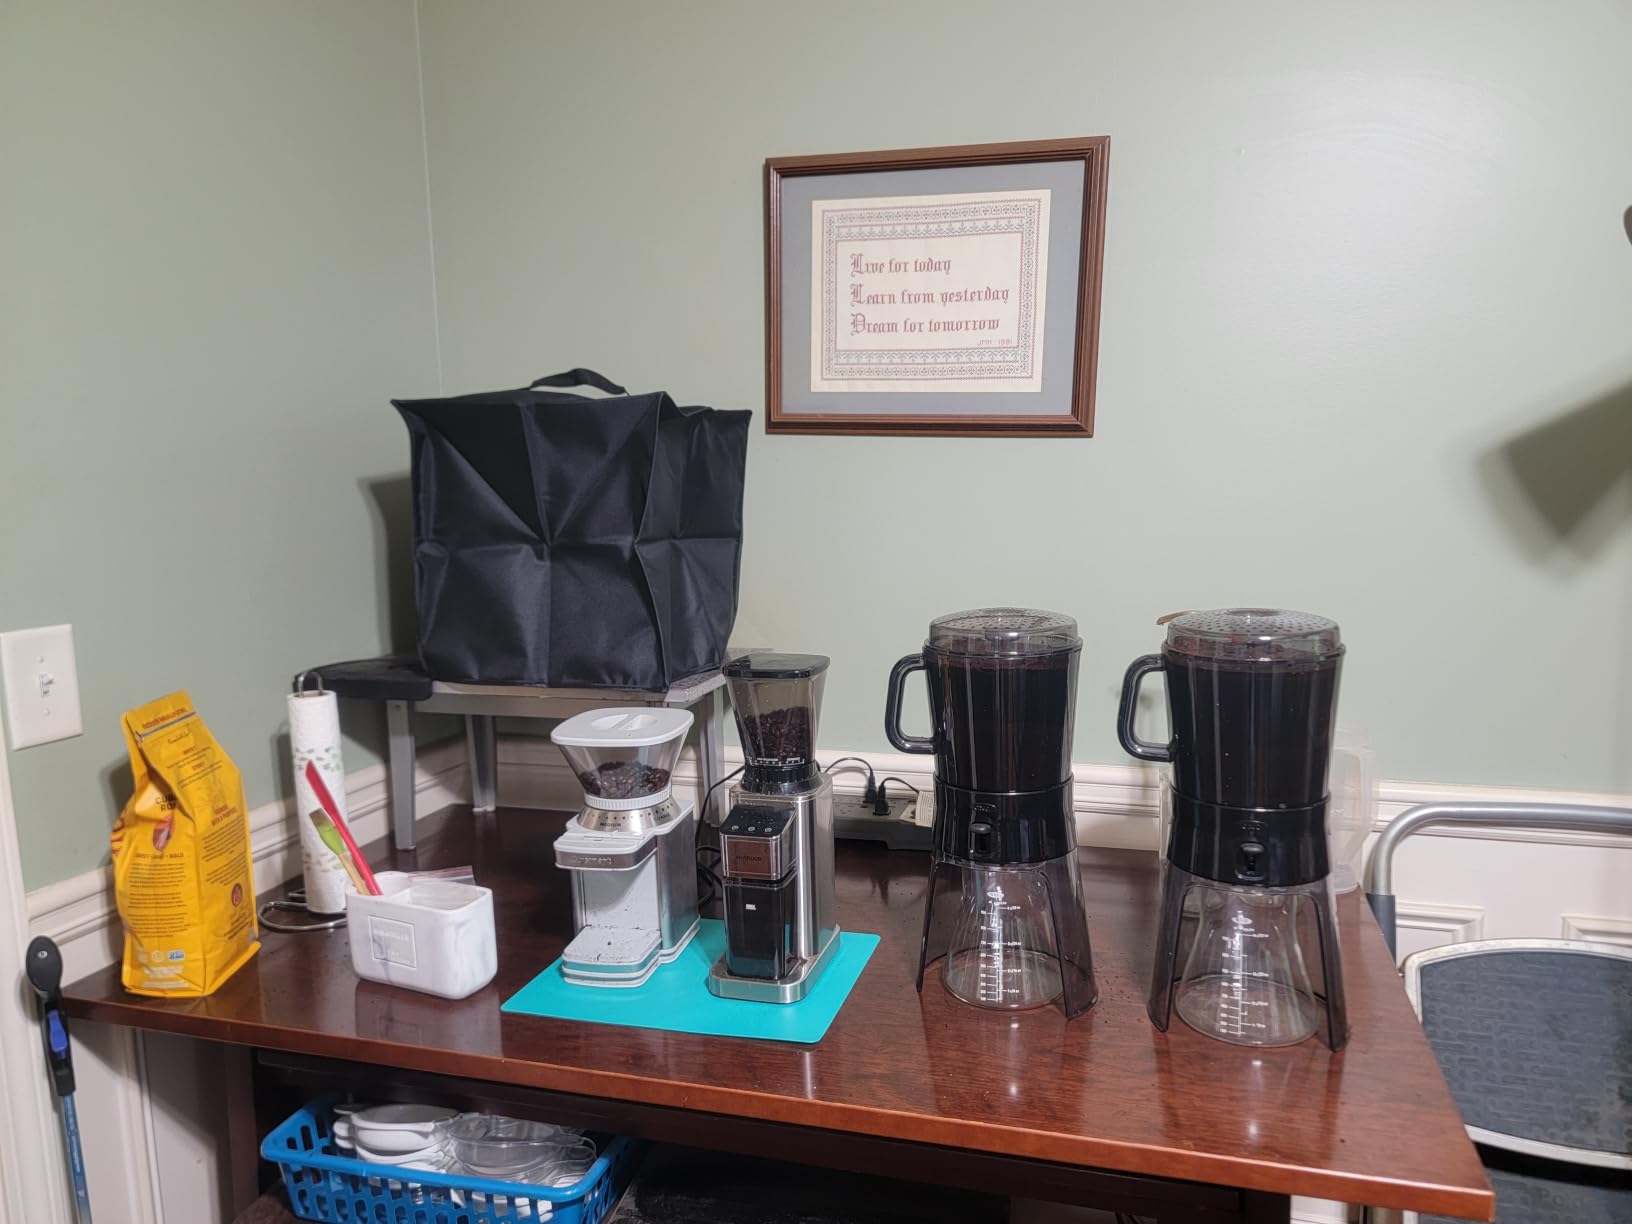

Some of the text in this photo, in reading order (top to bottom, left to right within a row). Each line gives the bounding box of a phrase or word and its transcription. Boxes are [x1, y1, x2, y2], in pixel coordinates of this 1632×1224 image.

[850, 253, 951, 277] Live for today
[850, 283, 1010, 307] Learn from yesterday
[850, 312, 1000, 336] Dream for tomorrow
